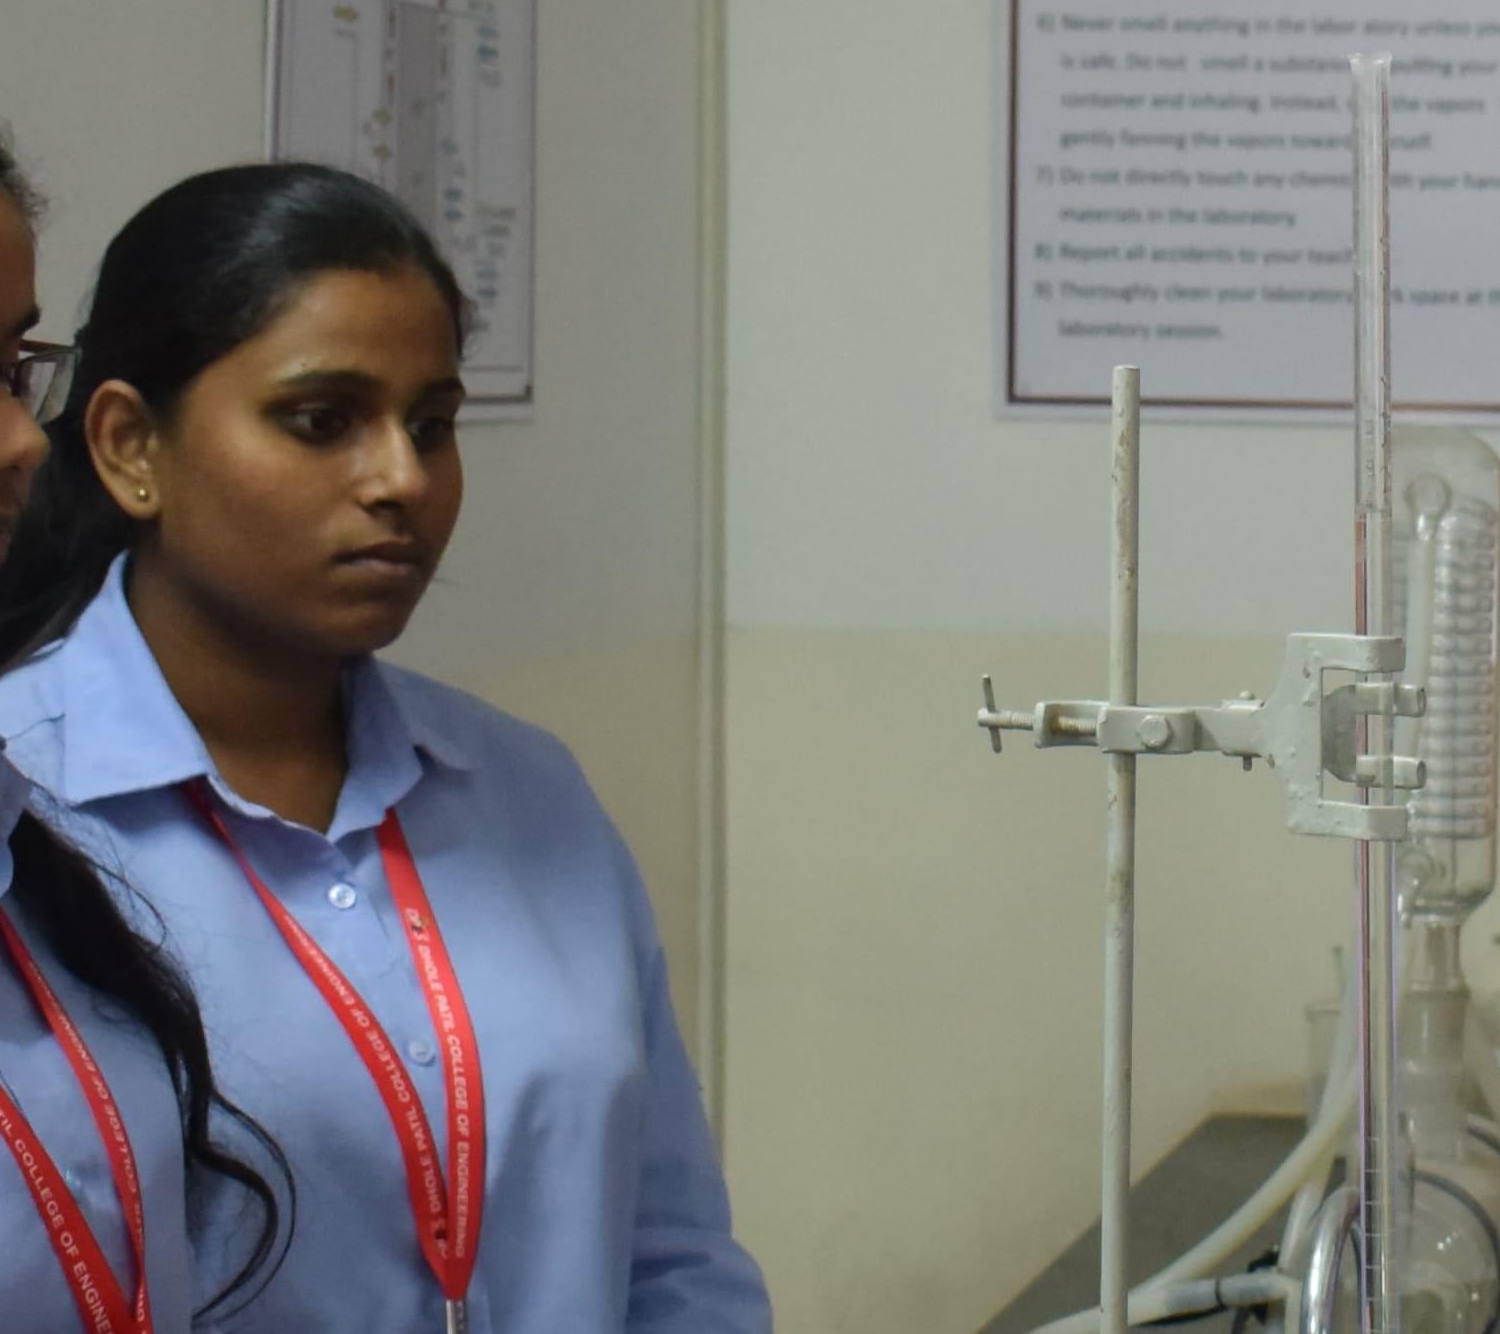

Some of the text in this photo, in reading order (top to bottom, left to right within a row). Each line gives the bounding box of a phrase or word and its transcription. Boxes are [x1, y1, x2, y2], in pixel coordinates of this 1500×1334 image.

[349, 1008, 371, 1028] OF
[366, 1029, 411, 1105] COLLEGE
[447, 1034, 469, 1110] COLLEGE
[456, 1112, 470, 1138] OF
[15, 1138, 65, 1229] COLLEGE
[59, 1230, 81, 1260] OF
